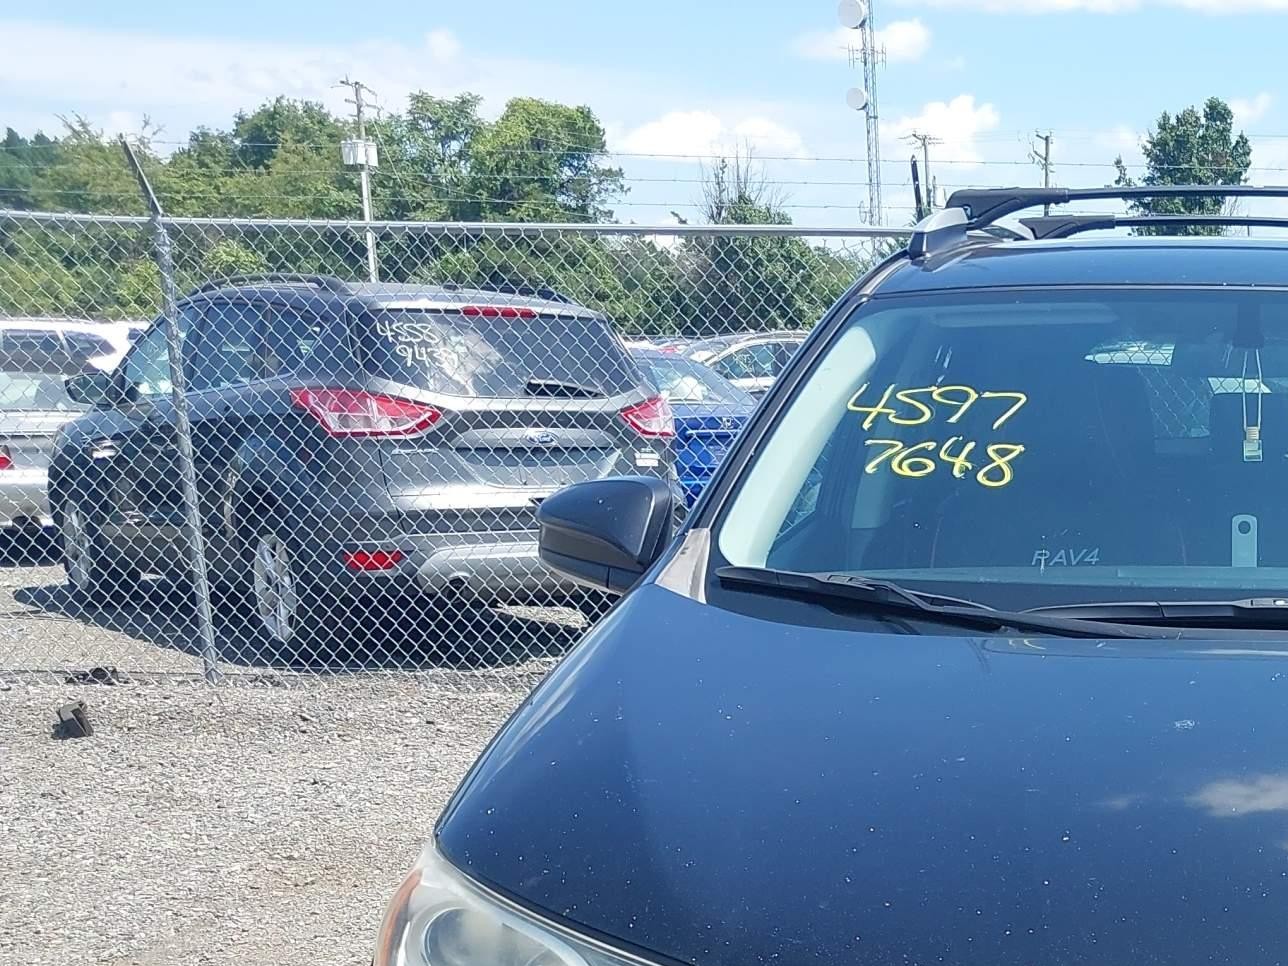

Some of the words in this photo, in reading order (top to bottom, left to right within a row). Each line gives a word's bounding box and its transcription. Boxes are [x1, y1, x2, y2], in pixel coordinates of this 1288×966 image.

[847, 381, 1027, 431] 4597
[864, 436, 1025, 487] 7648
[1031, 547, 1100, 566] RAV4
